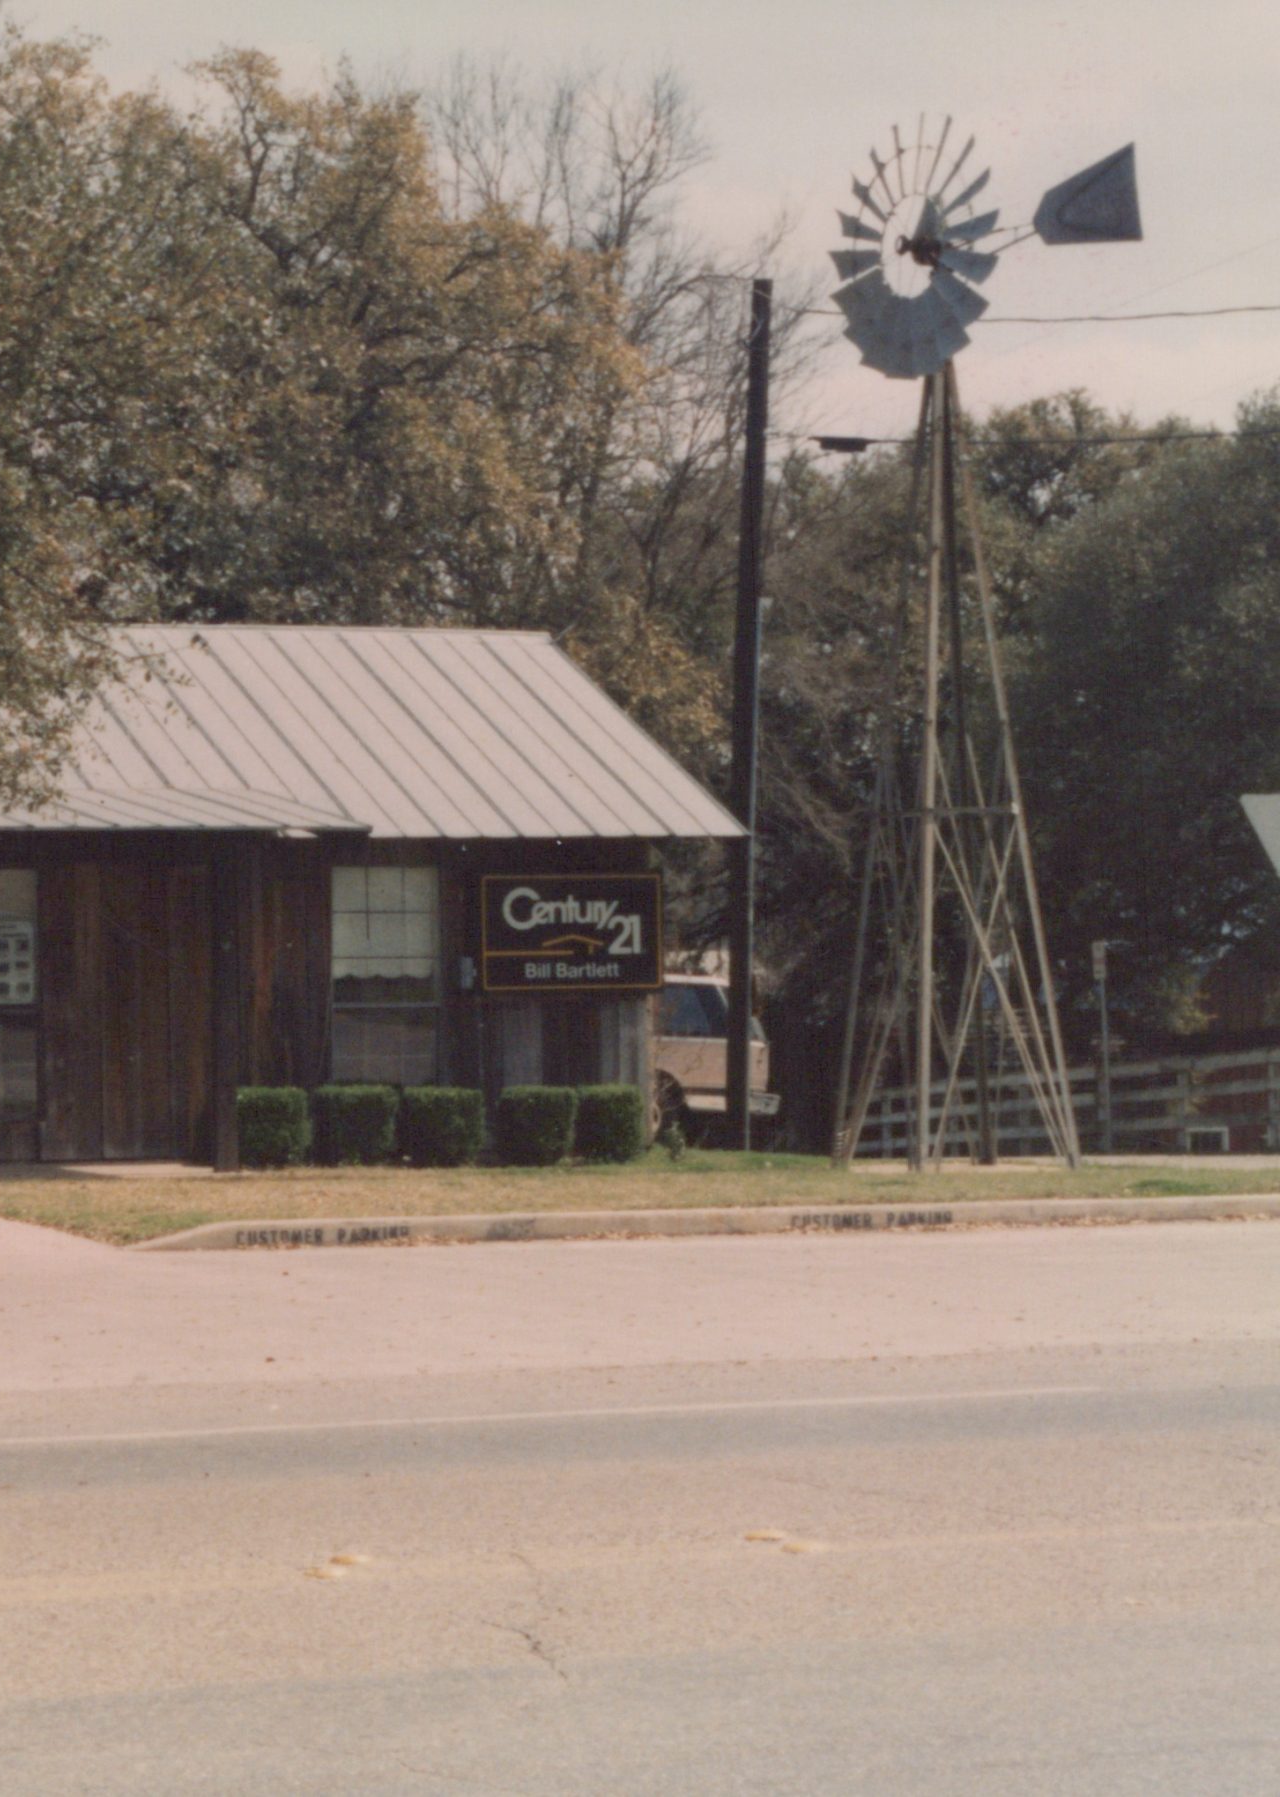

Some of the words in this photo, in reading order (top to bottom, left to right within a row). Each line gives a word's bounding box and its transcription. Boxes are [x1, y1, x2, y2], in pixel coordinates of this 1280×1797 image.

[502, 887, 619, 931] Century
[608, 914, 642, 955] 21
[524, 963, 551, 979] Bill
[555, 962, 620, 979] Bartlett
[791, 1212, 873, 1229] CUSTOMER
[235, 1228, 323, 1245] CUSTOMER
